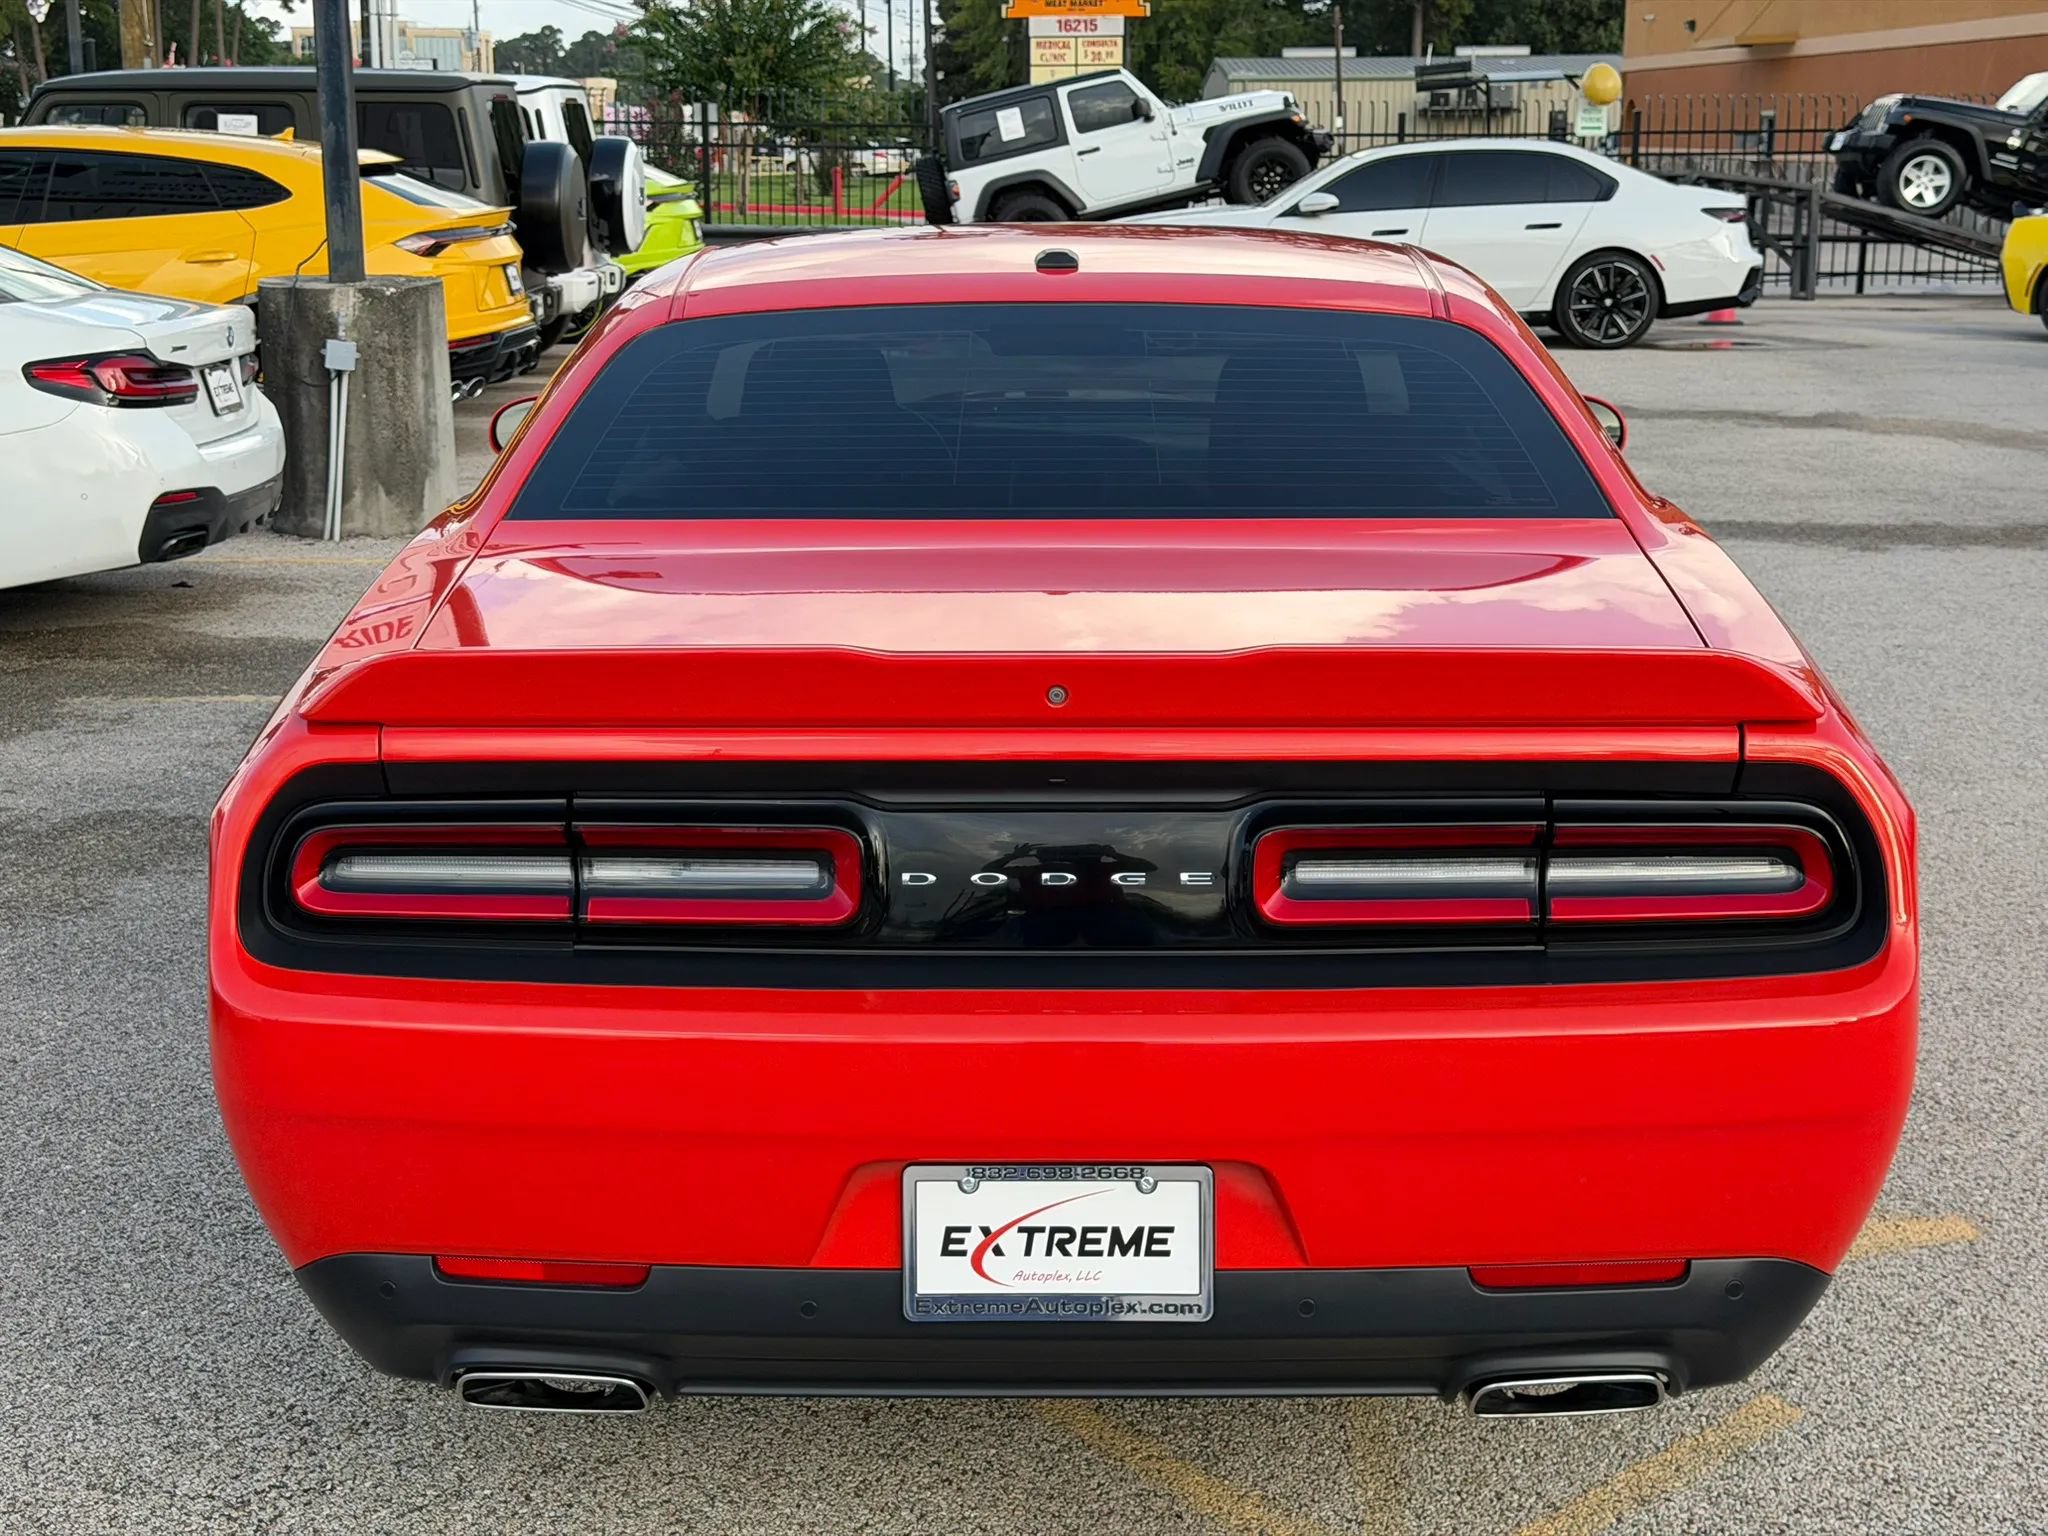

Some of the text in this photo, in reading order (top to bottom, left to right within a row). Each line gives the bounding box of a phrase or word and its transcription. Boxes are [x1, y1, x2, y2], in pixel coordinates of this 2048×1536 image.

[1056, 18, 1098, 32] 16215
[902, 872, 1213, 885] DODGE
[968, 1167, 1146, 1180] 832-698-2668
[940, 1225, 1175, 1257] EXTREME
[1012, 1269, 1103, 1285] Autoplex, LLC
[915, 1297, 1202, 1317] ExtremeAutoplex.com
